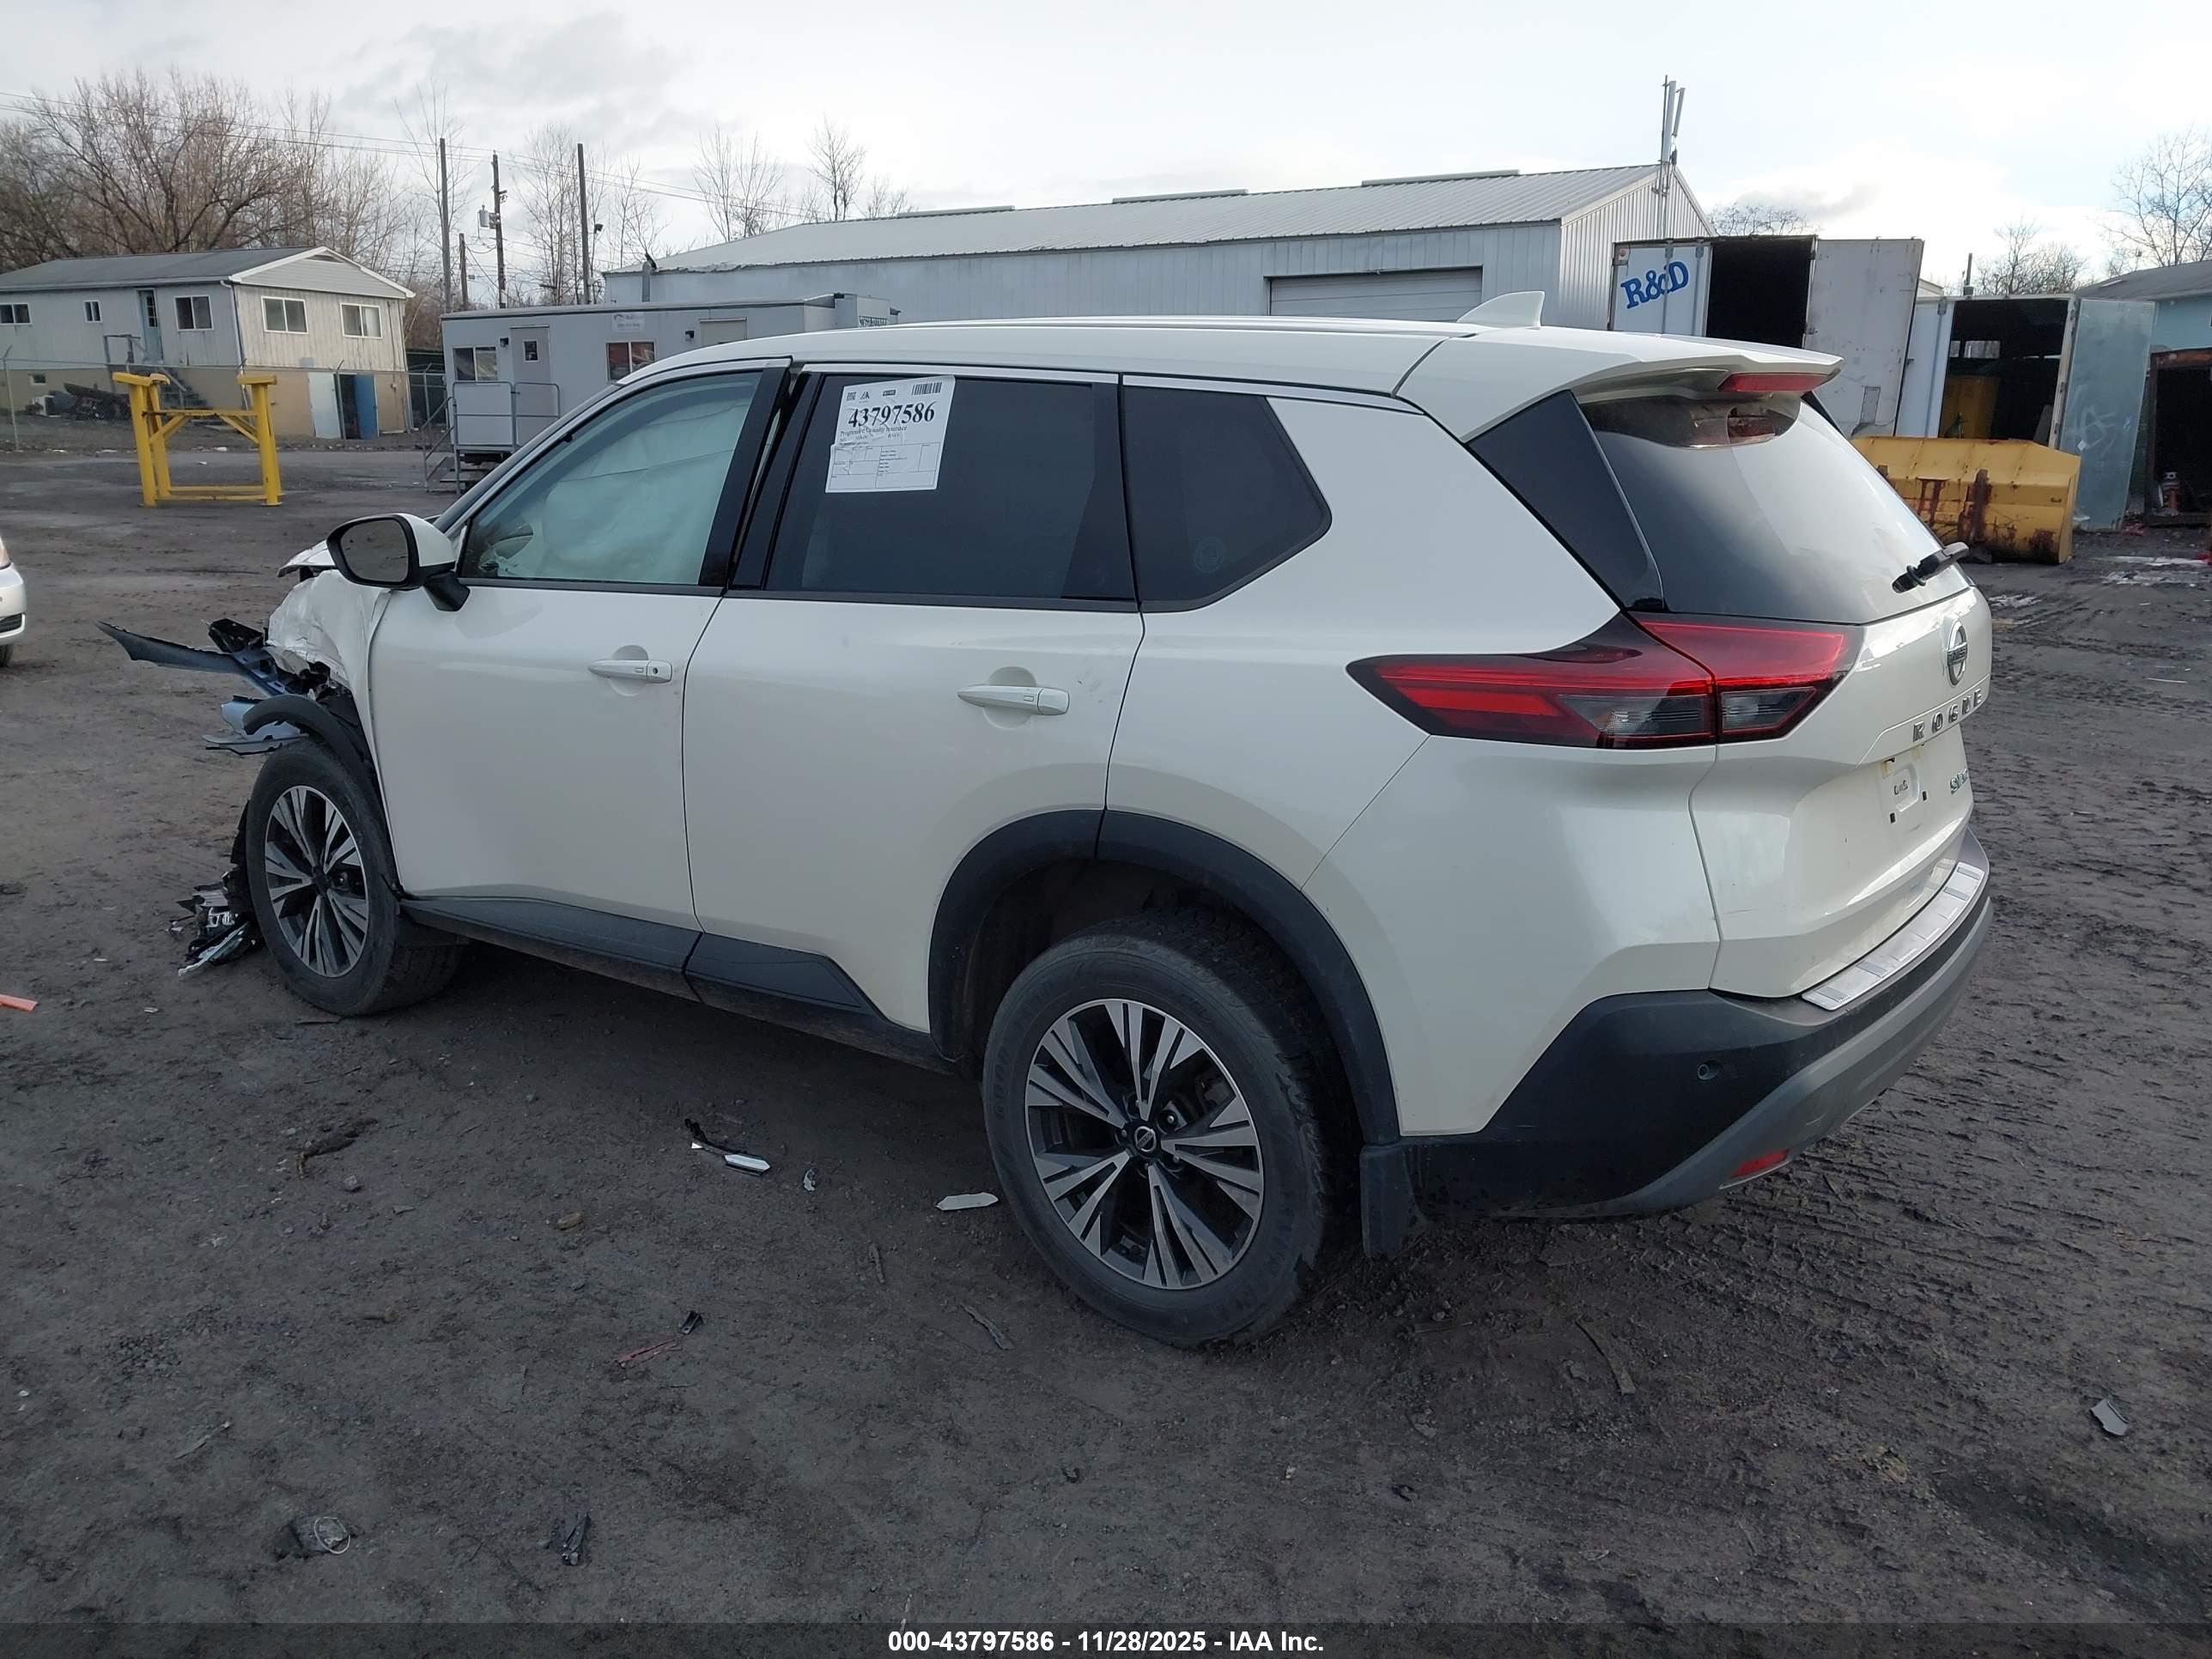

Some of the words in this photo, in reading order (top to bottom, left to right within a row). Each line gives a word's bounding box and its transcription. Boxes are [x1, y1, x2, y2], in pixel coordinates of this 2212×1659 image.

[1620, 261, 1689, 309] R&D
[840, 428, 866, 437] Progressie
[848, 401, 938, 428] 43797586
[1913, 688, 1982, 743] ROGUE
